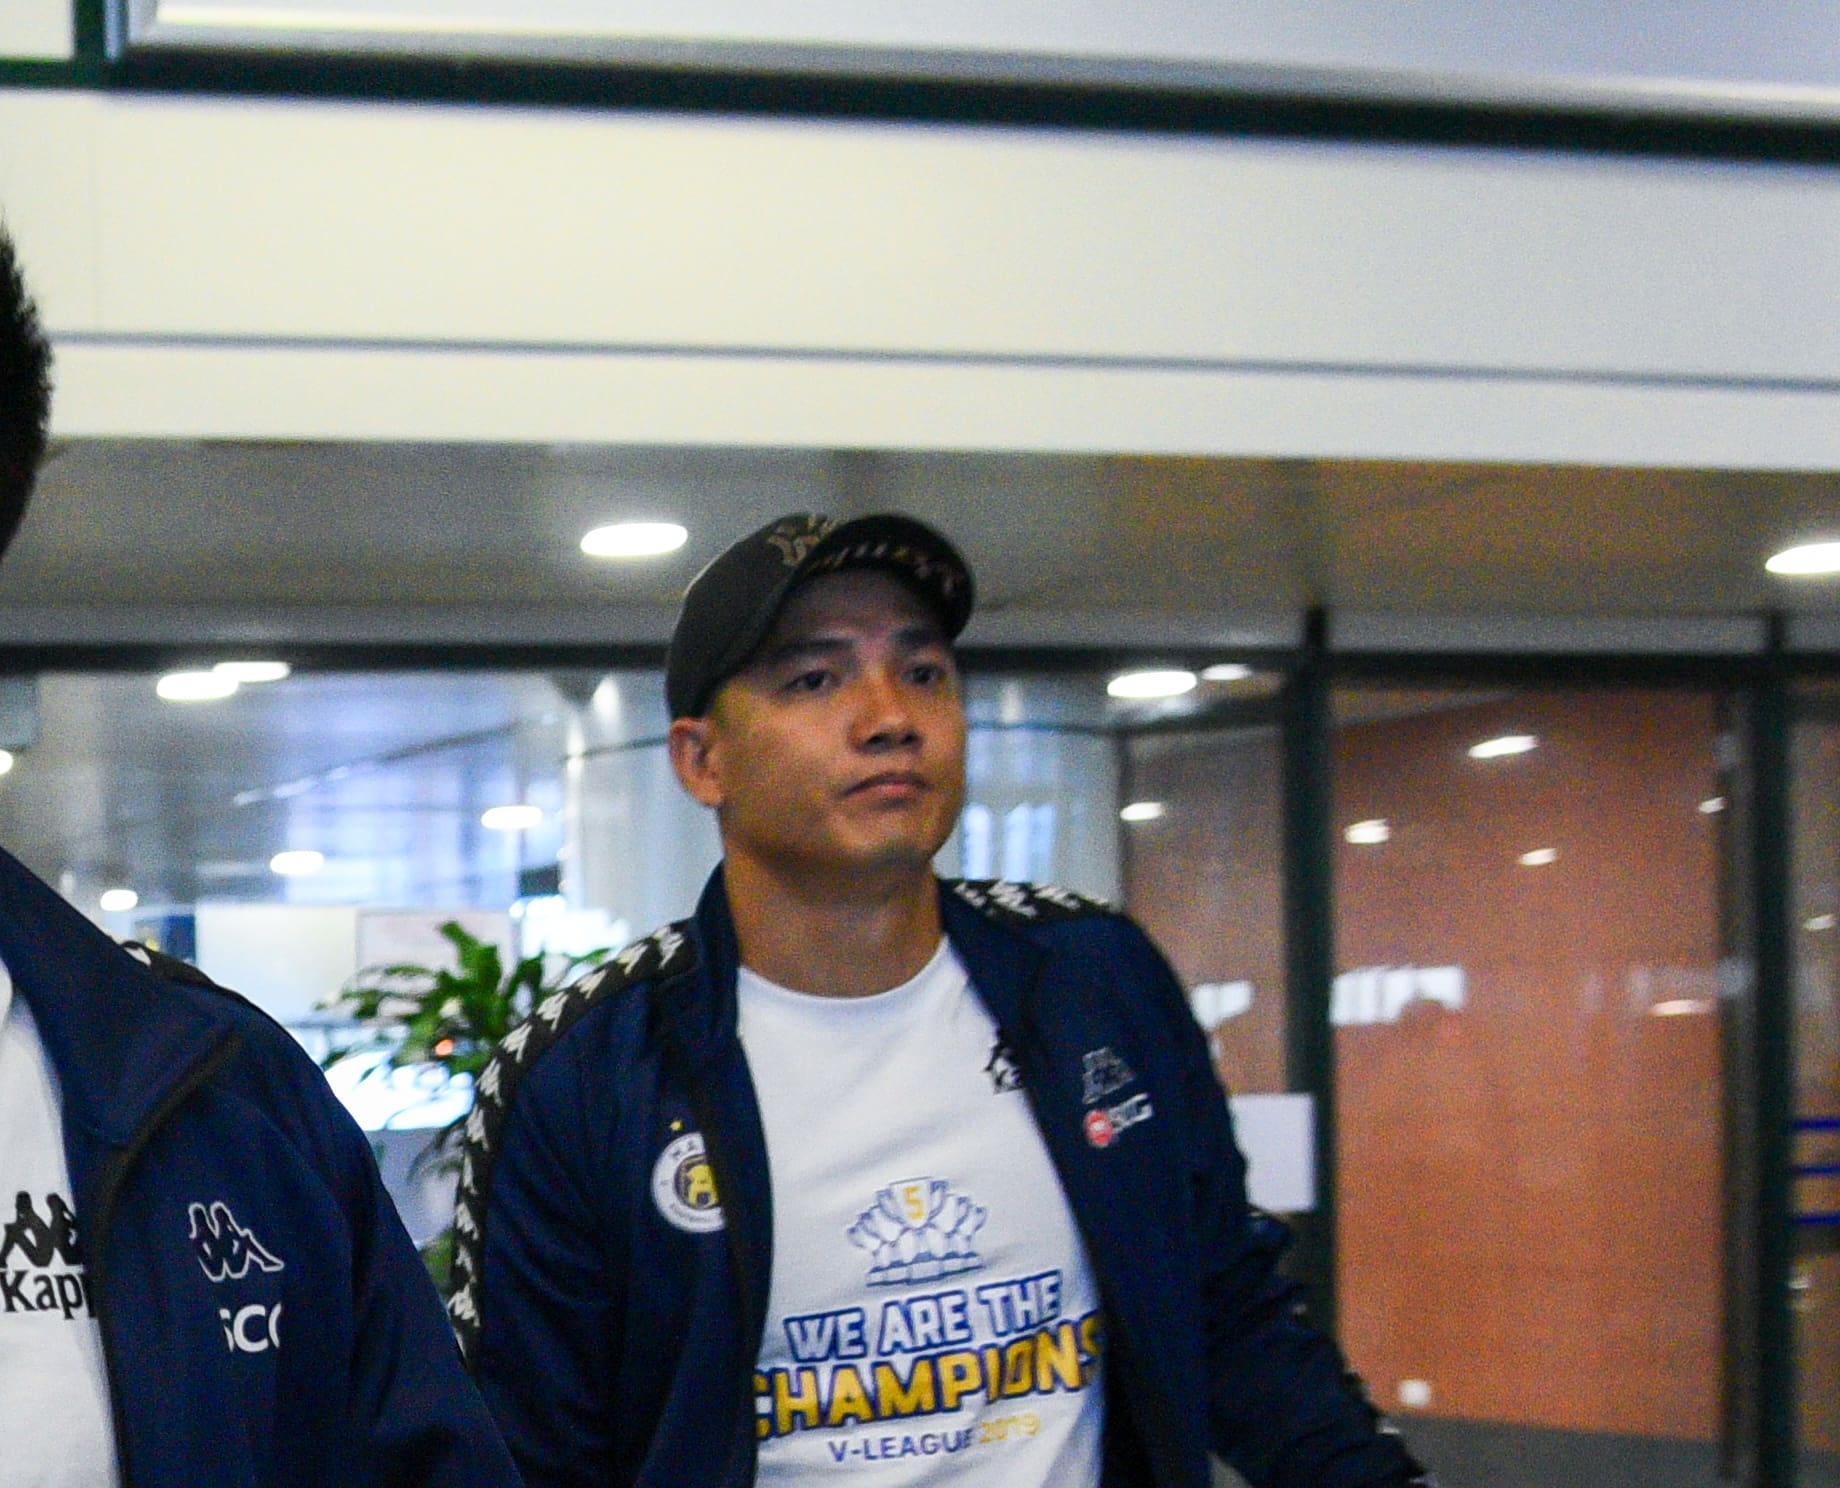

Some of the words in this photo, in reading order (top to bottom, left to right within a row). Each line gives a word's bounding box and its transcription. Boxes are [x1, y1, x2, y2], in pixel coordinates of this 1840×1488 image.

[904, 1186, 927, 1221] 5
[783, 1307, 868, 1363] WE
[878, 1290, 973, 1357] ARE
[976, 1269, 1063, 1338] THE
[827, 1425, 973, 1464] V-LEAGUE
